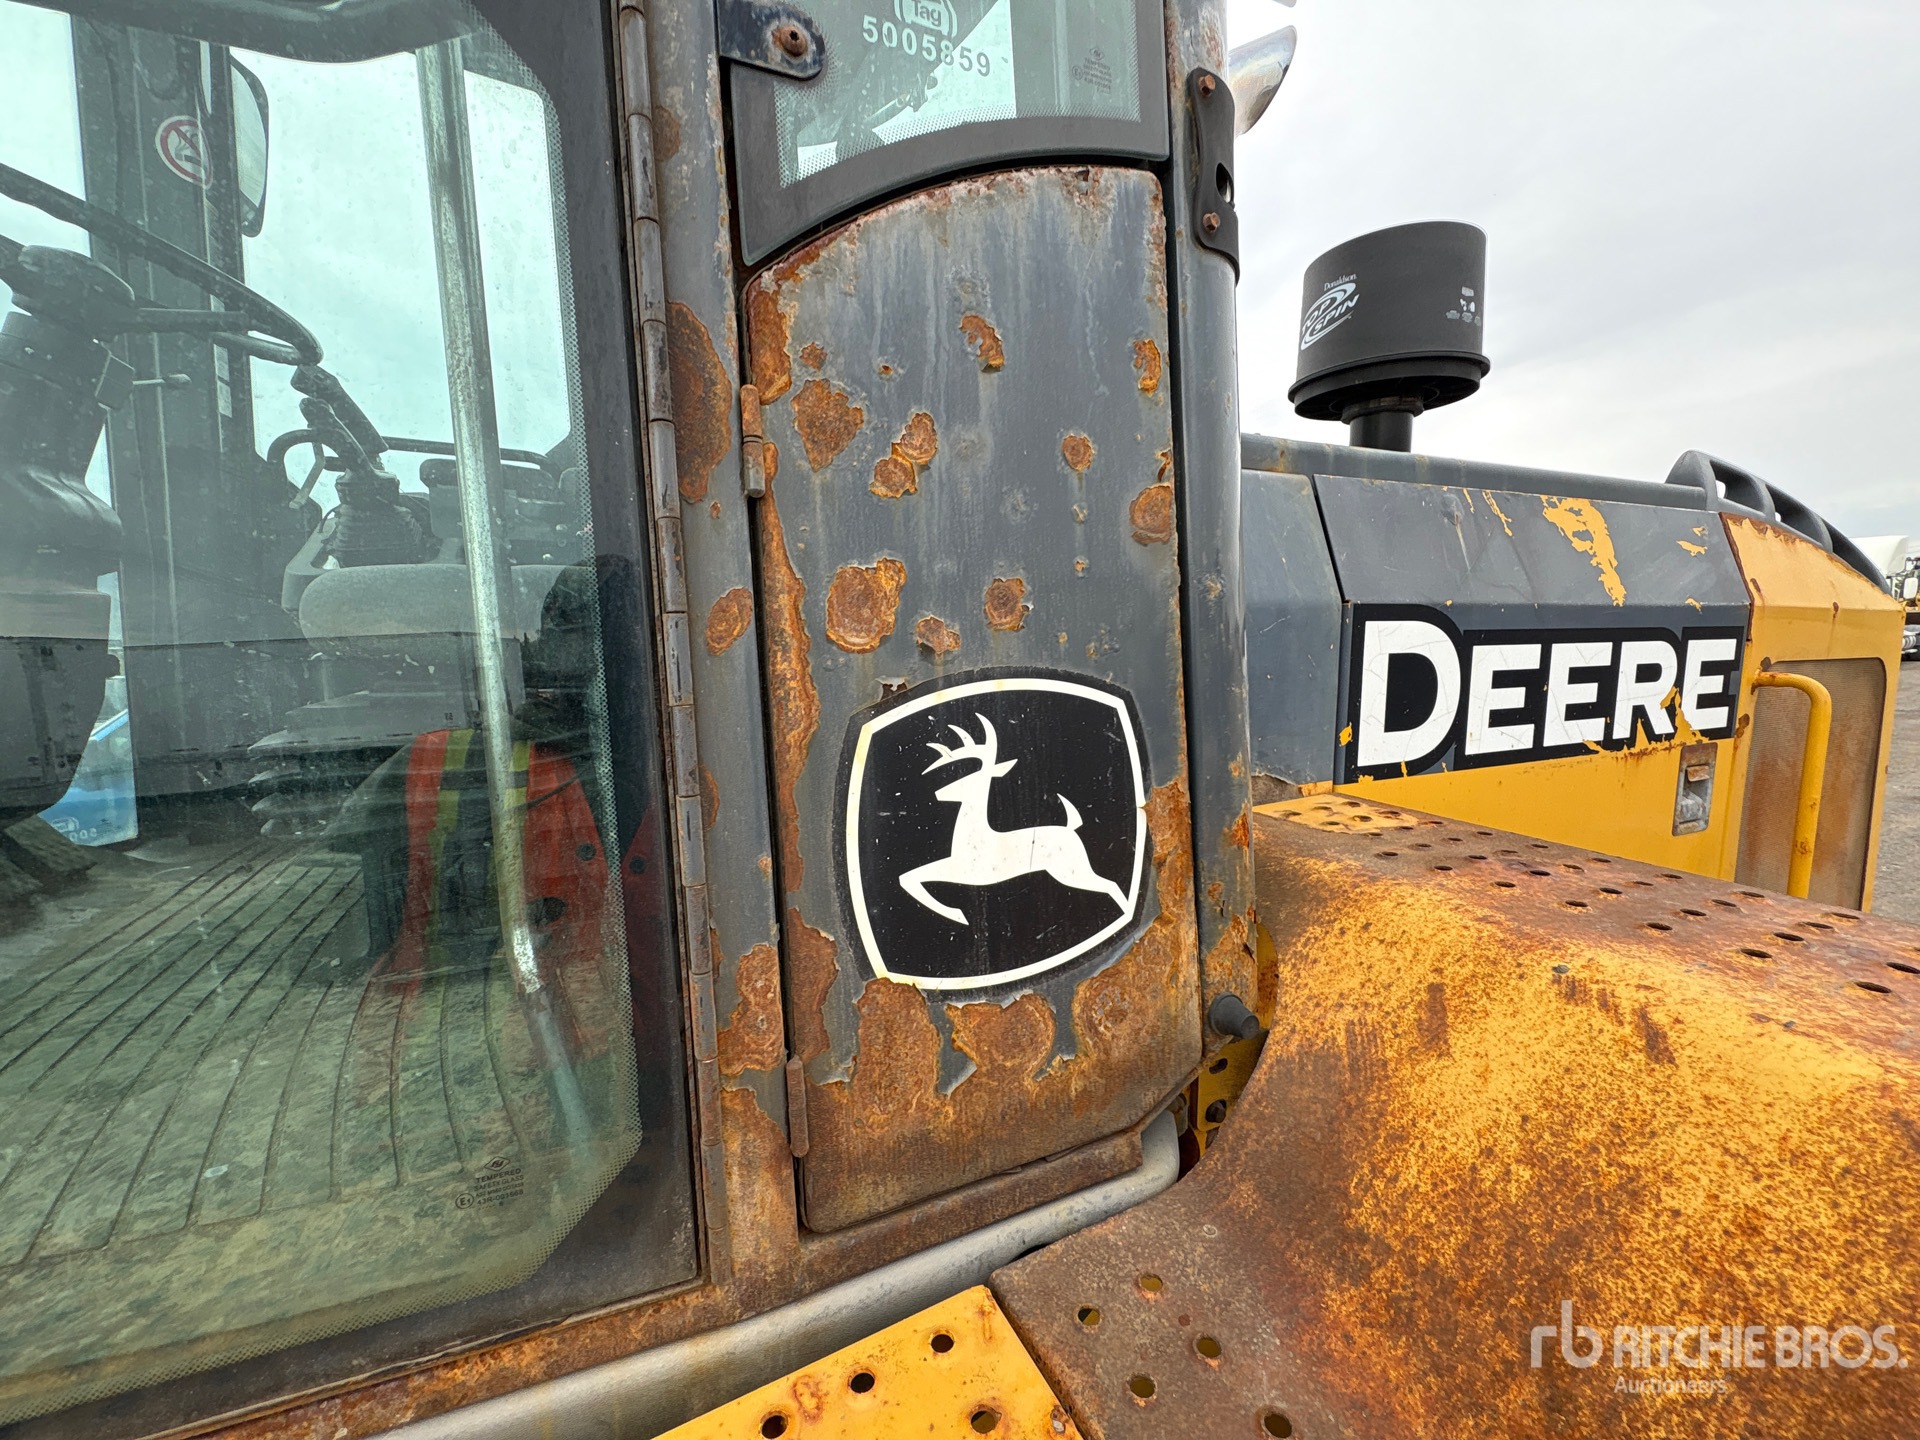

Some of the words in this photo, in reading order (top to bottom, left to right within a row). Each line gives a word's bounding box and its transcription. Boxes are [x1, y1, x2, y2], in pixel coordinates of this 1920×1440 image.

[862, 14, 991, 77] 5005859
[1323, 273, 1357, 291] Donaldson
[1302, 299, 1331, 335] TOP
[1313, 294, 1360, 335] SPIN
[1356, 620, 1738, 767] DEERE
[474, 1181, 501, 1192] SAFETY
[501, 1174, 524, 1185] GLASS
[476, 1168, 522, 1183] TEMPERED
